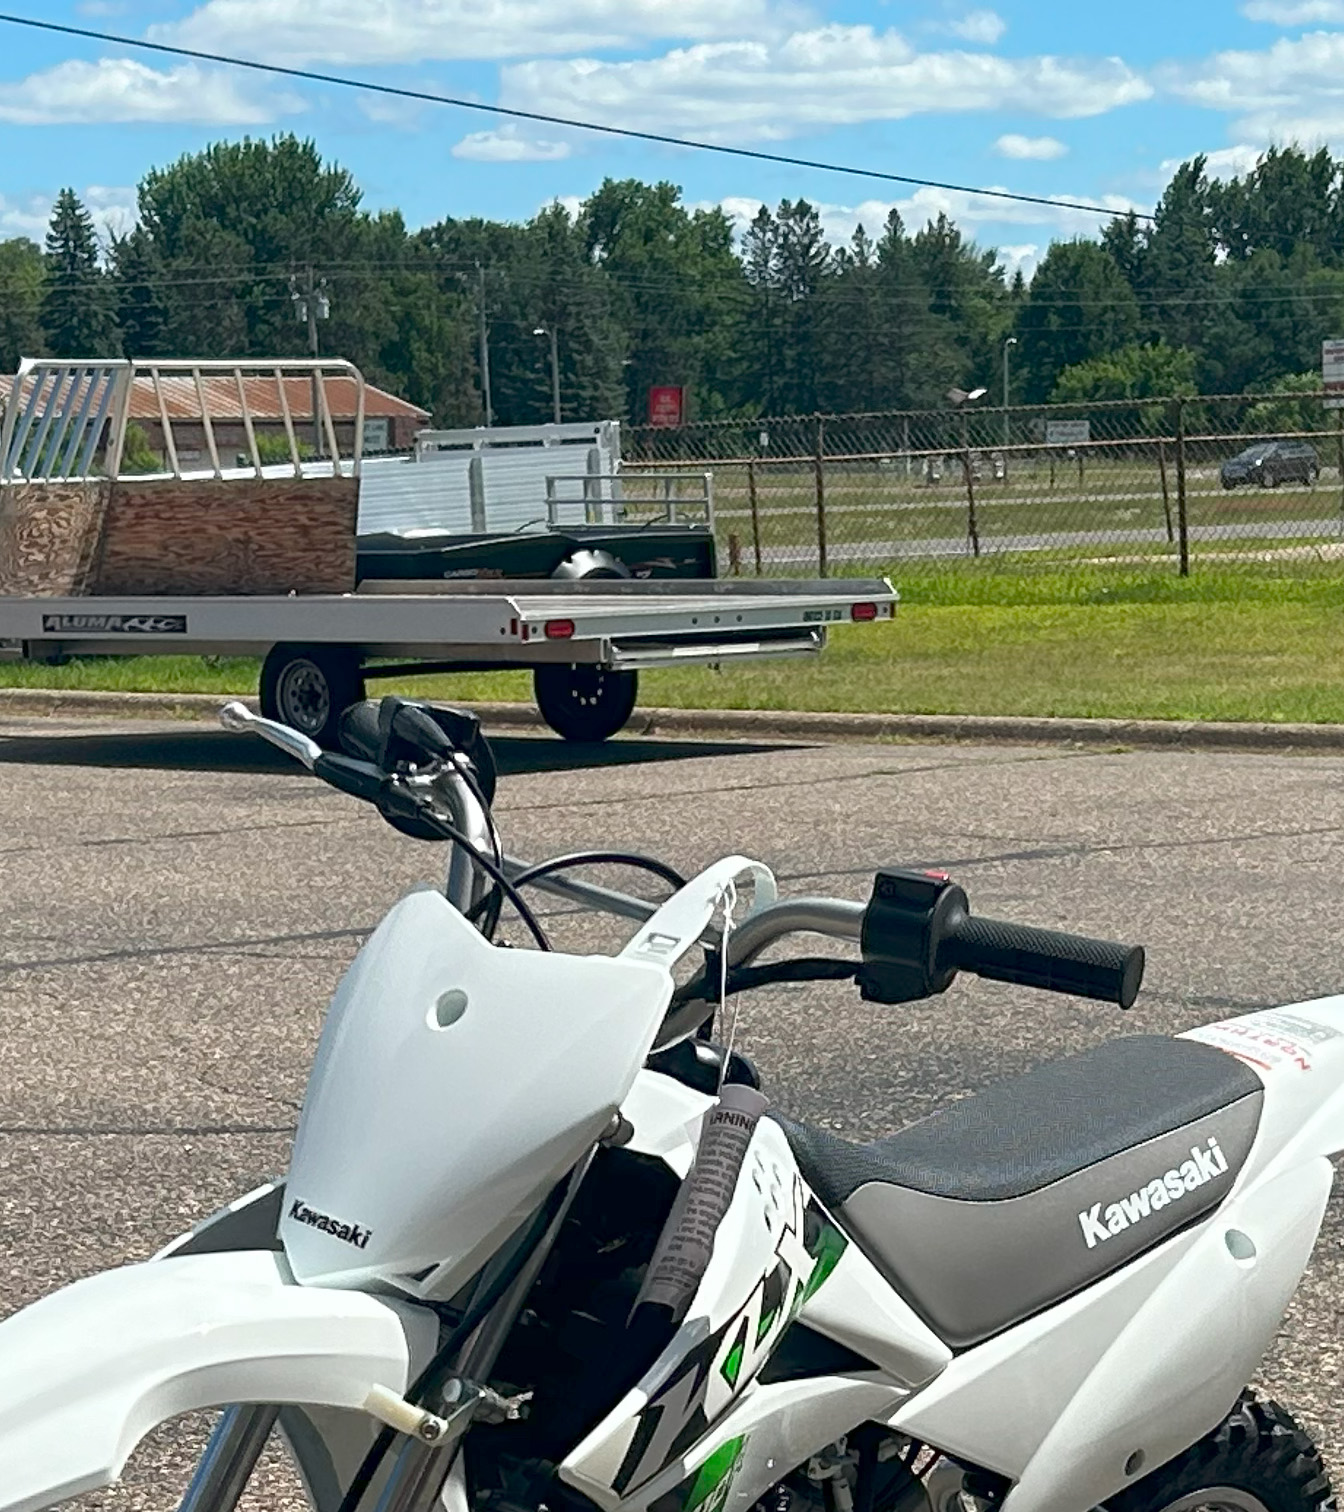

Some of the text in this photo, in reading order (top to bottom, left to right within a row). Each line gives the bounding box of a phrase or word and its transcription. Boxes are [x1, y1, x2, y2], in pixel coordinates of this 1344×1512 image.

[46, 616, 122, 630] ALUMA
[709, 1111, 757, 1134] ARNIN
[1078, 1136, 1229, 1249] Kawasaki
[288, 1199, 373, 1249] Kawasaki
